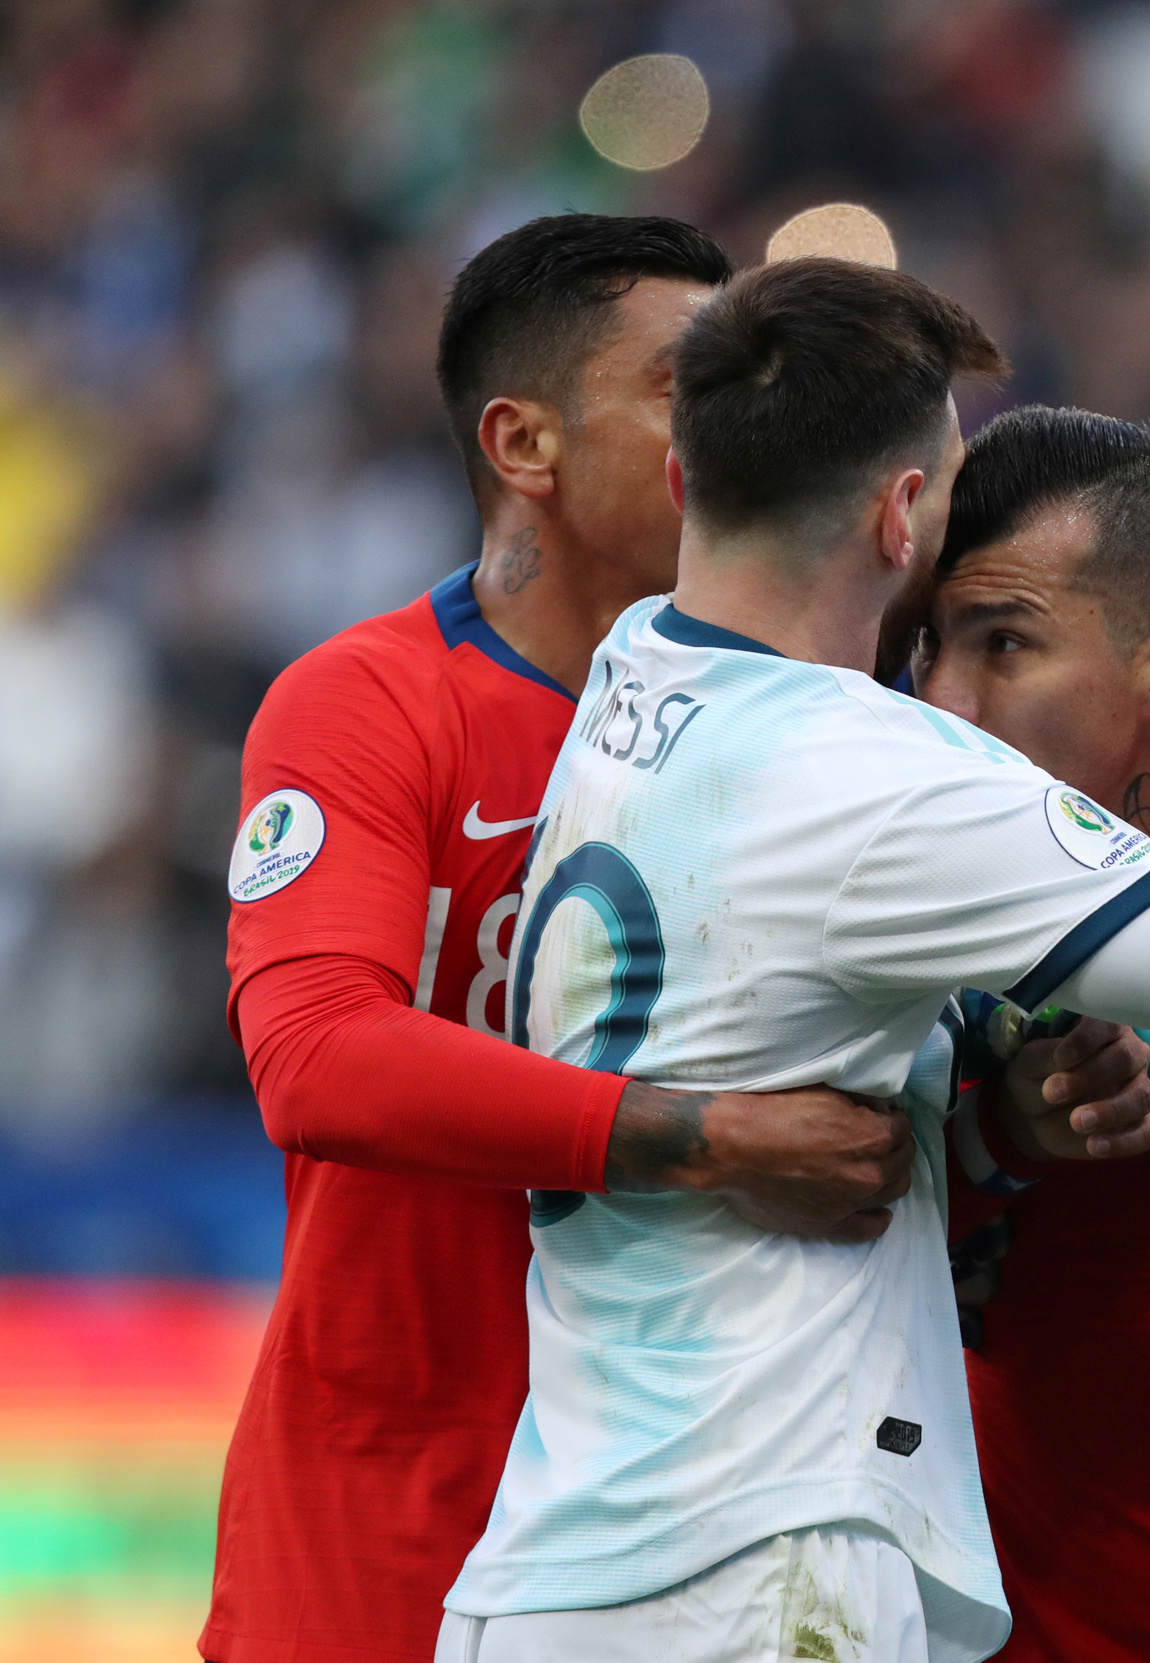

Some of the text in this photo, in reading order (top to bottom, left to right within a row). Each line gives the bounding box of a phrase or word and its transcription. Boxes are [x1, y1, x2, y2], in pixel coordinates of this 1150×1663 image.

[579, 660, 707, 775] MESSI
[233, 851, 311, 894] COPA AMERICA
[276, 864, 300, 880] 2019
[1100, 848, 1125, 869] COPA
[512, 817, 665, 1228] 0
